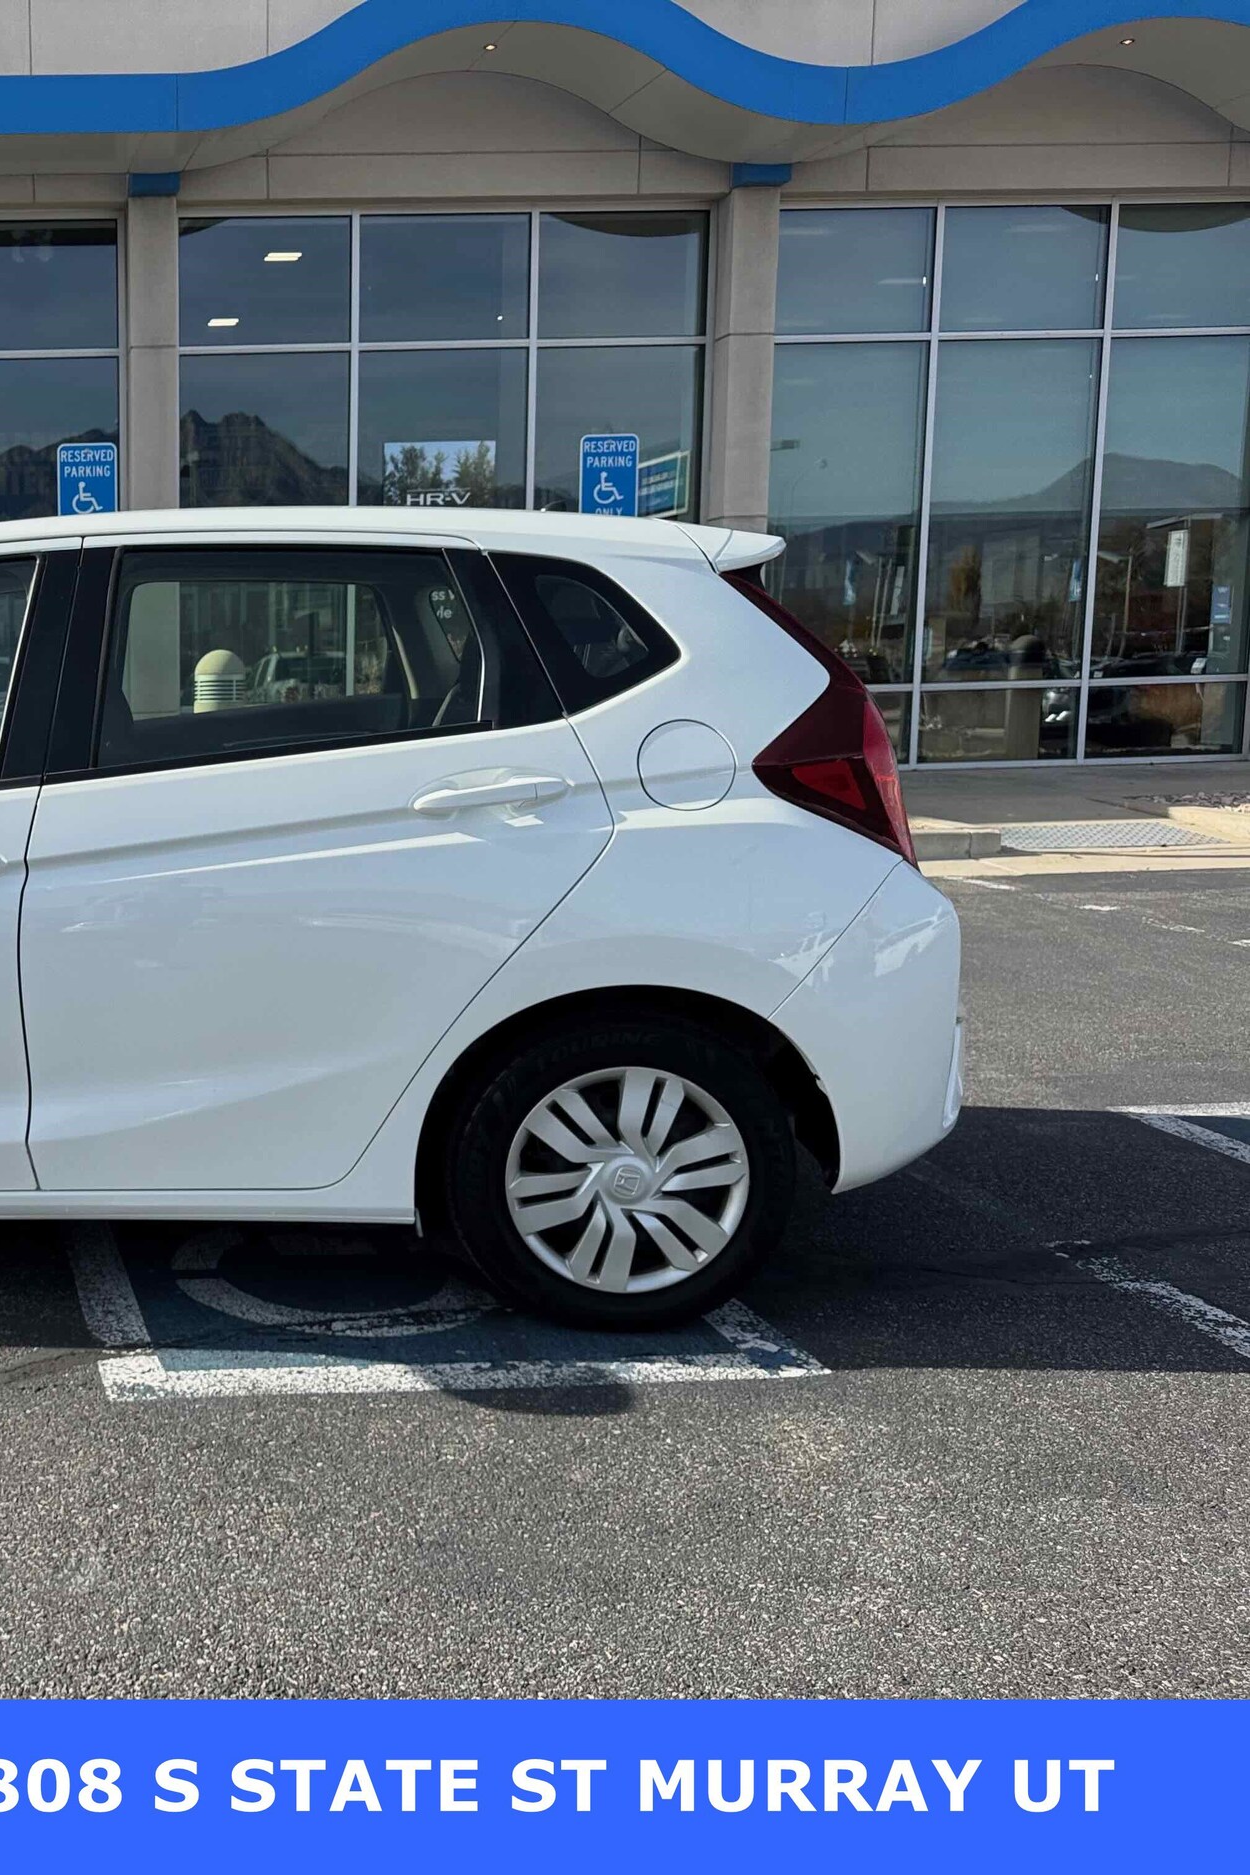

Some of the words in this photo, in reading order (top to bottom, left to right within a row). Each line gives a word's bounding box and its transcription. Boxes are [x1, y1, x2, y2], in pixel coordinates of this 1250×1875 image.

[583, 440, 636, 453] RESERVED
[60, 449, 114, 463] RESERVED
[586, 455, 633, 468] PARKING
[63, 465, 111, 478] PARKING
[406, 491, 471, 506] HR-V
